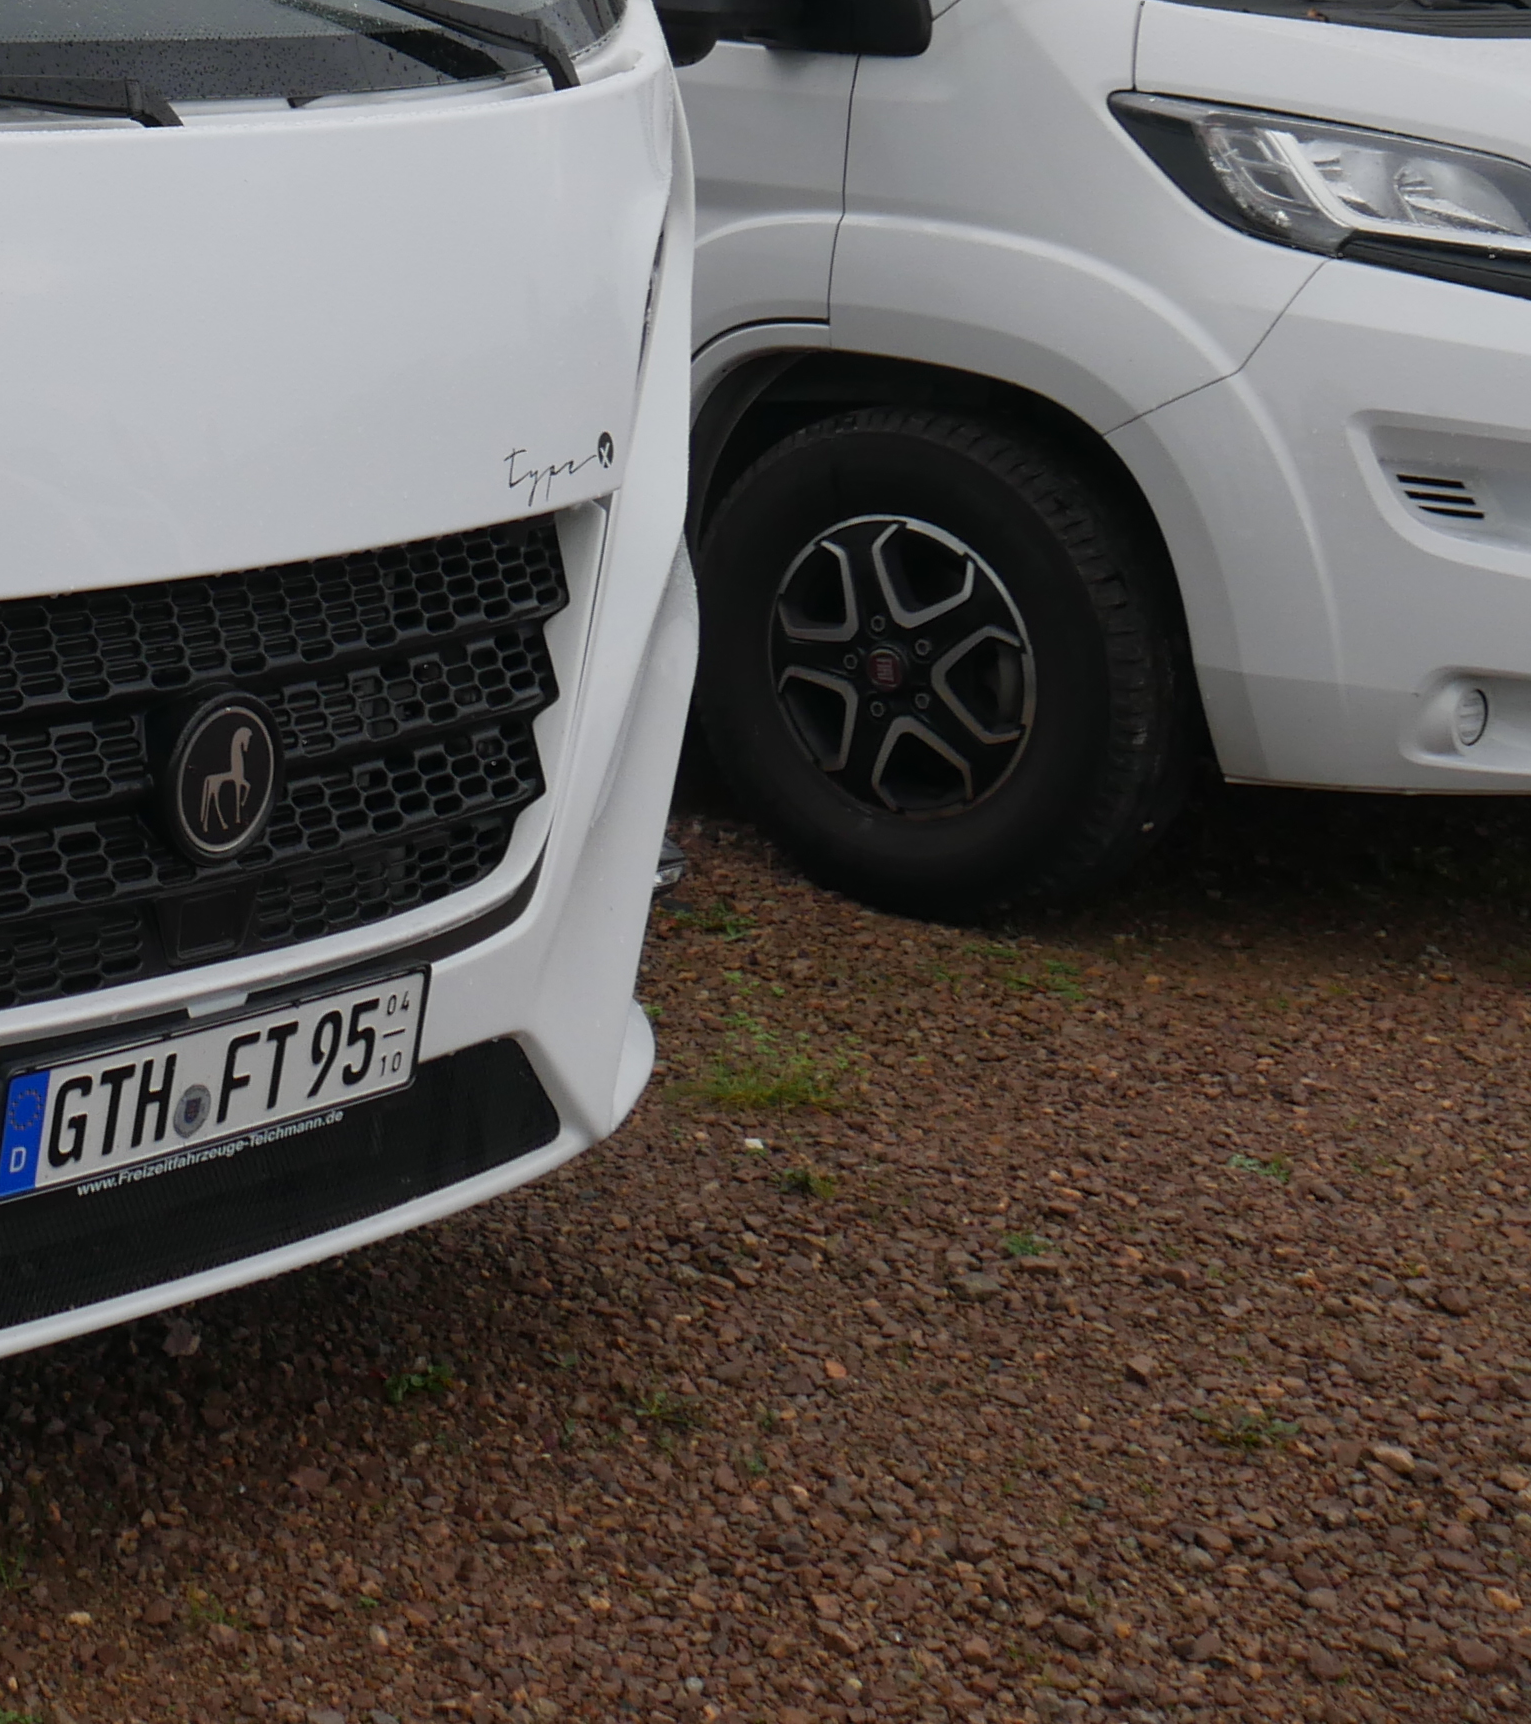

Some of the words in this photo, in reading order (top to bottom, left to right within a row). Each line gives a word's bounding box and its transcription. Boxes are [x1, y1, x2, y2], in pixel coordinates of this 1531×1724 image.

[386, 989, 411, 1016] 04
[379, 1050, 403, 1078] 10
[46, 1052, 178, 1169] GTH
[9, 1146, 28, 1174] D
[76, 1109, 345, 1197] www.Freizeitfahrzeuge-Teichmann.de
